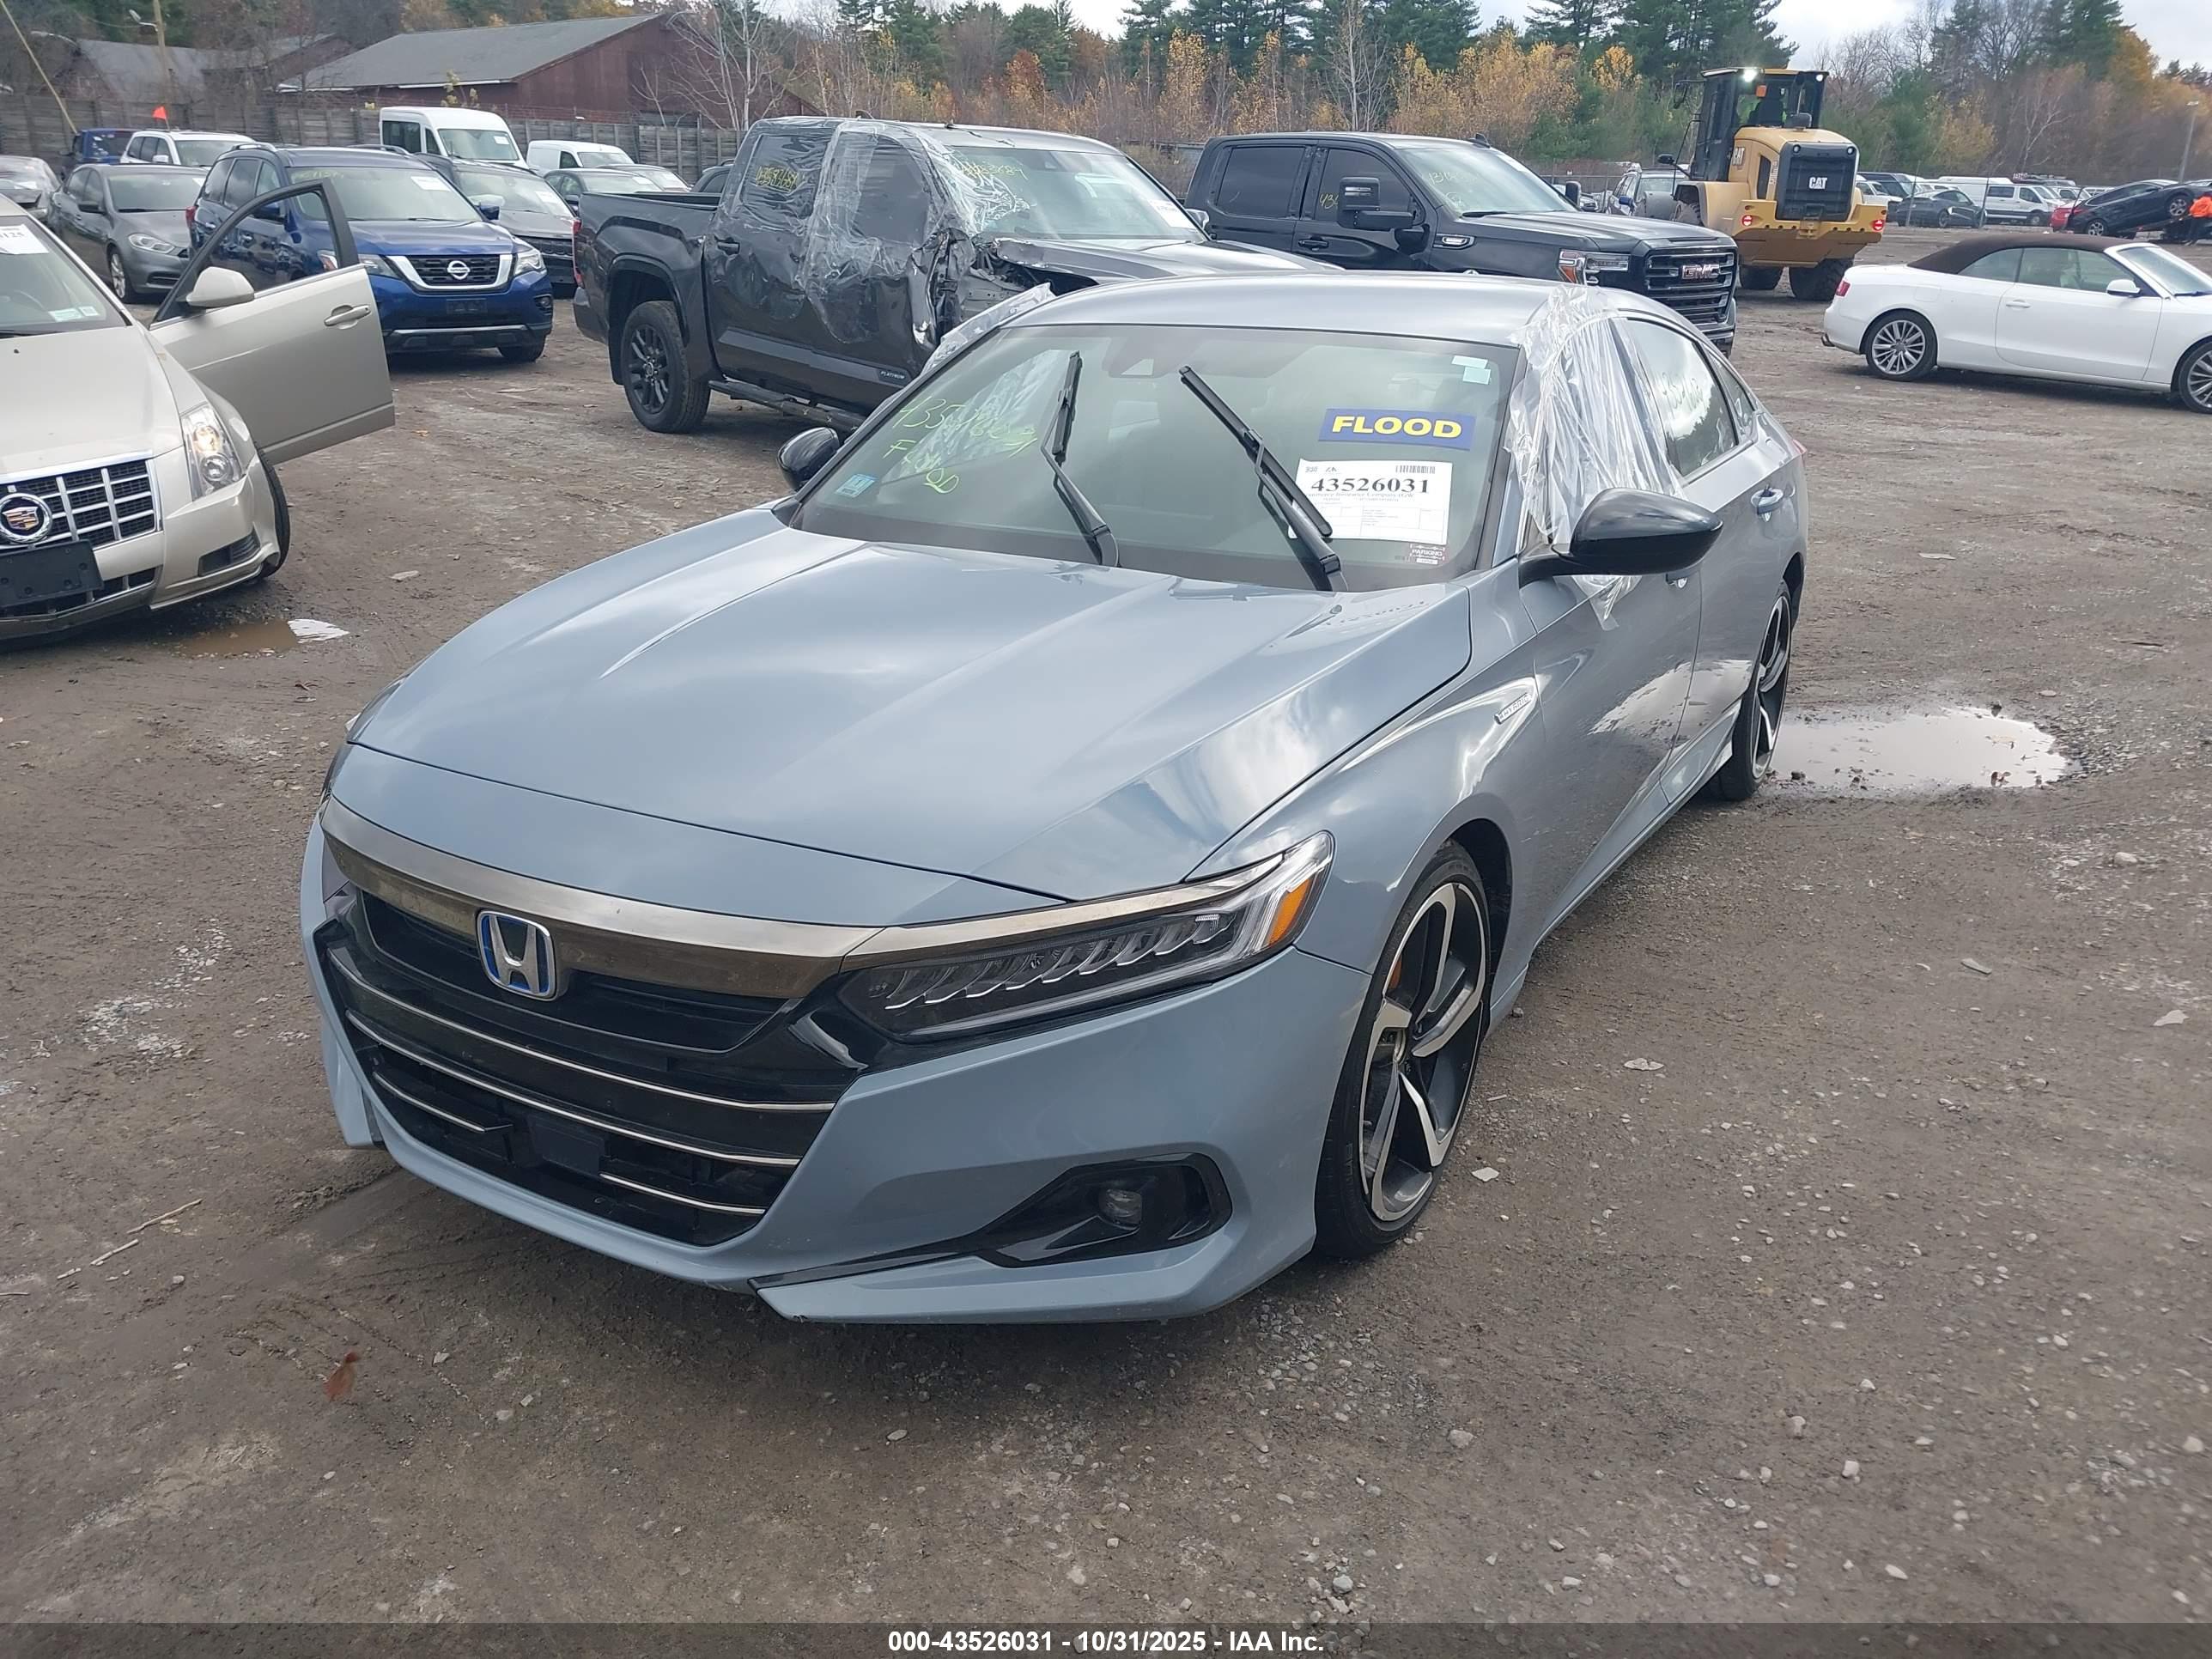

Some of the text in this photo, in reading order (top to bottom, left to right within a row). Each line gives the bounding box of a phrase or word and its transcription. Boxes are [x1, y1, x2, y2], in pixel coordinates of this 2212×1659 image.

[1808, 176, 1827, 190] CAT
[1682, 264, 1720, 280] GMC
[1332, 416, 1462, 439] FLOOD
[1310, 477, 1429, 494] 43526031
